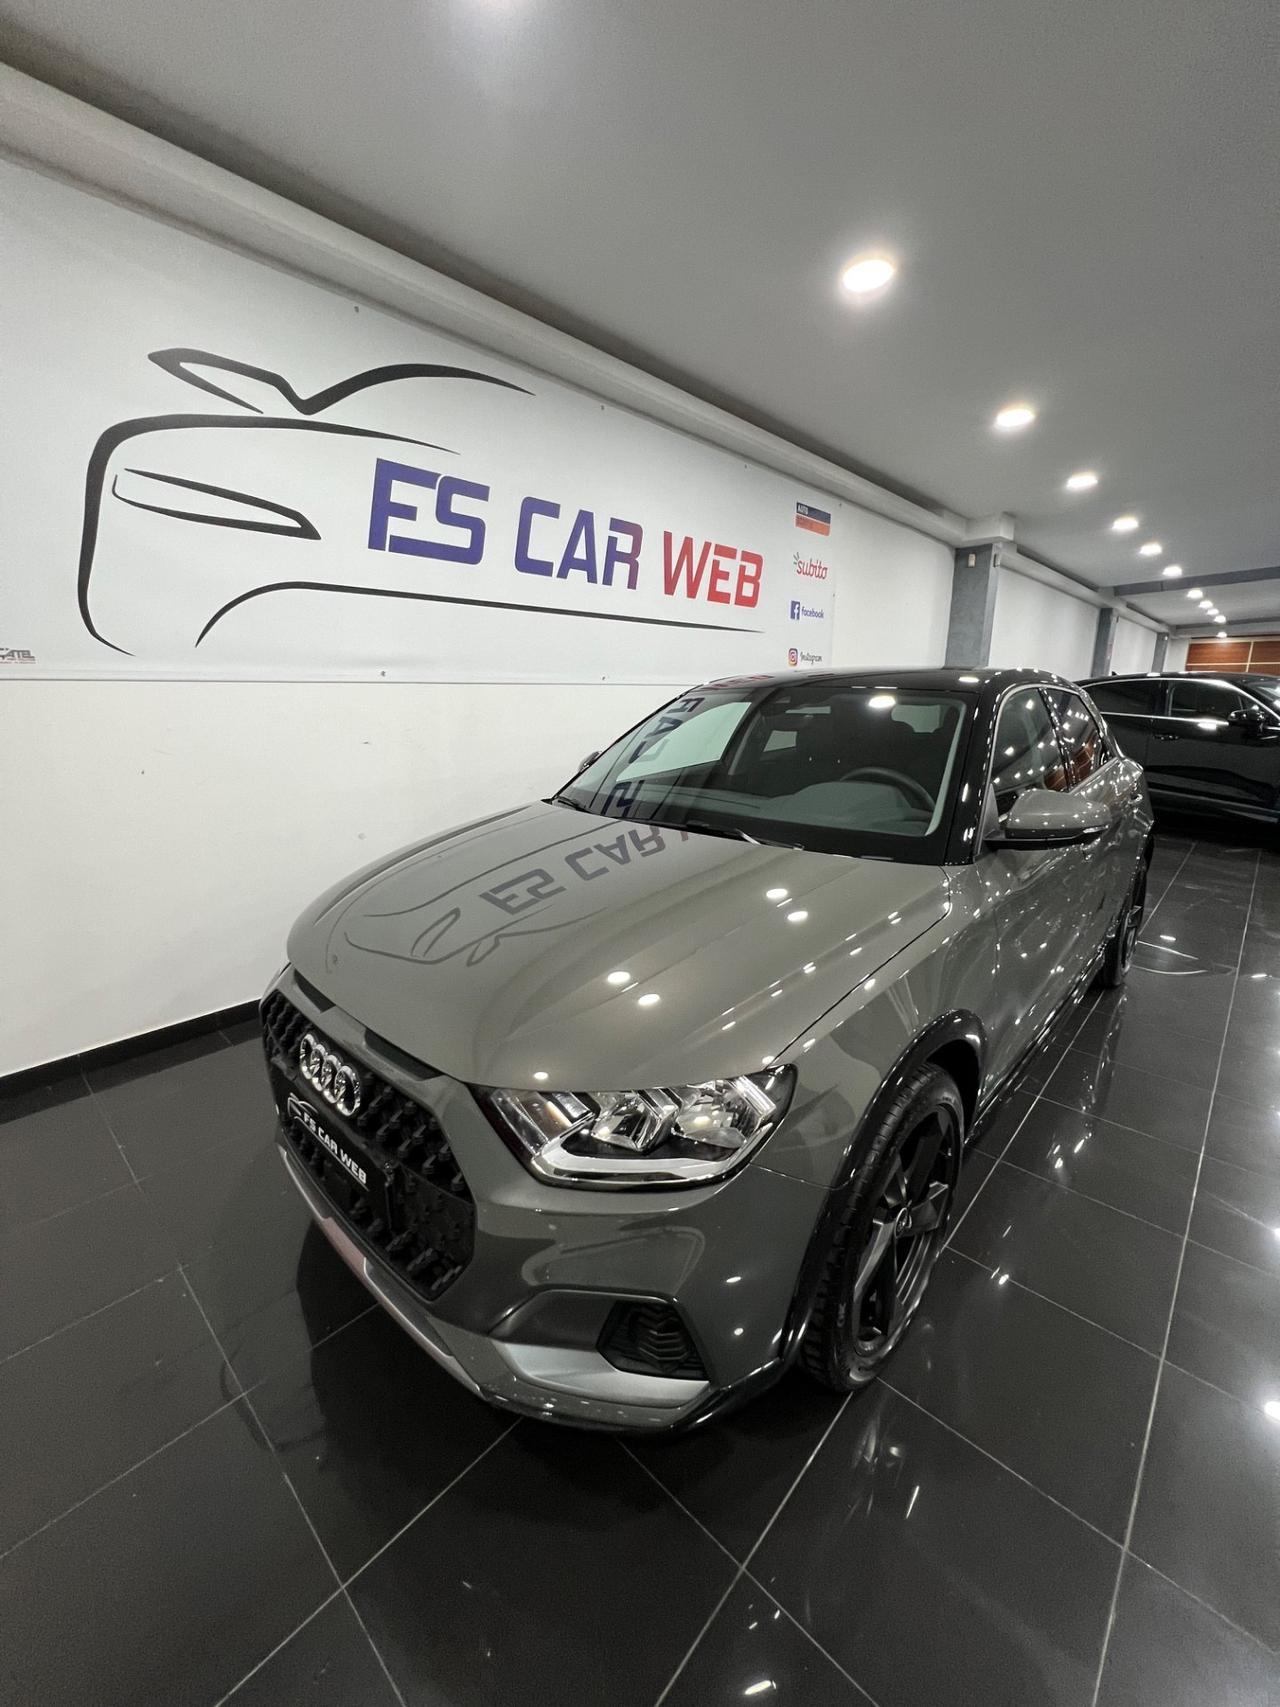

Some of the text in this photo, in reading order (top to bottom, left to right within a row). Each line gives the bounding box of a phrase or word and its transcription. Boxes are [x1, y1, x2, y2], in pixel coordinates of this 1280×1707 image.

[368, 457, 764, 608] ES CAR WEB
[797, 558, 828, 580] subito
[801, 606, 824, 619] facebook
[303, 1112, 367, 1185] ES CAR WEB
